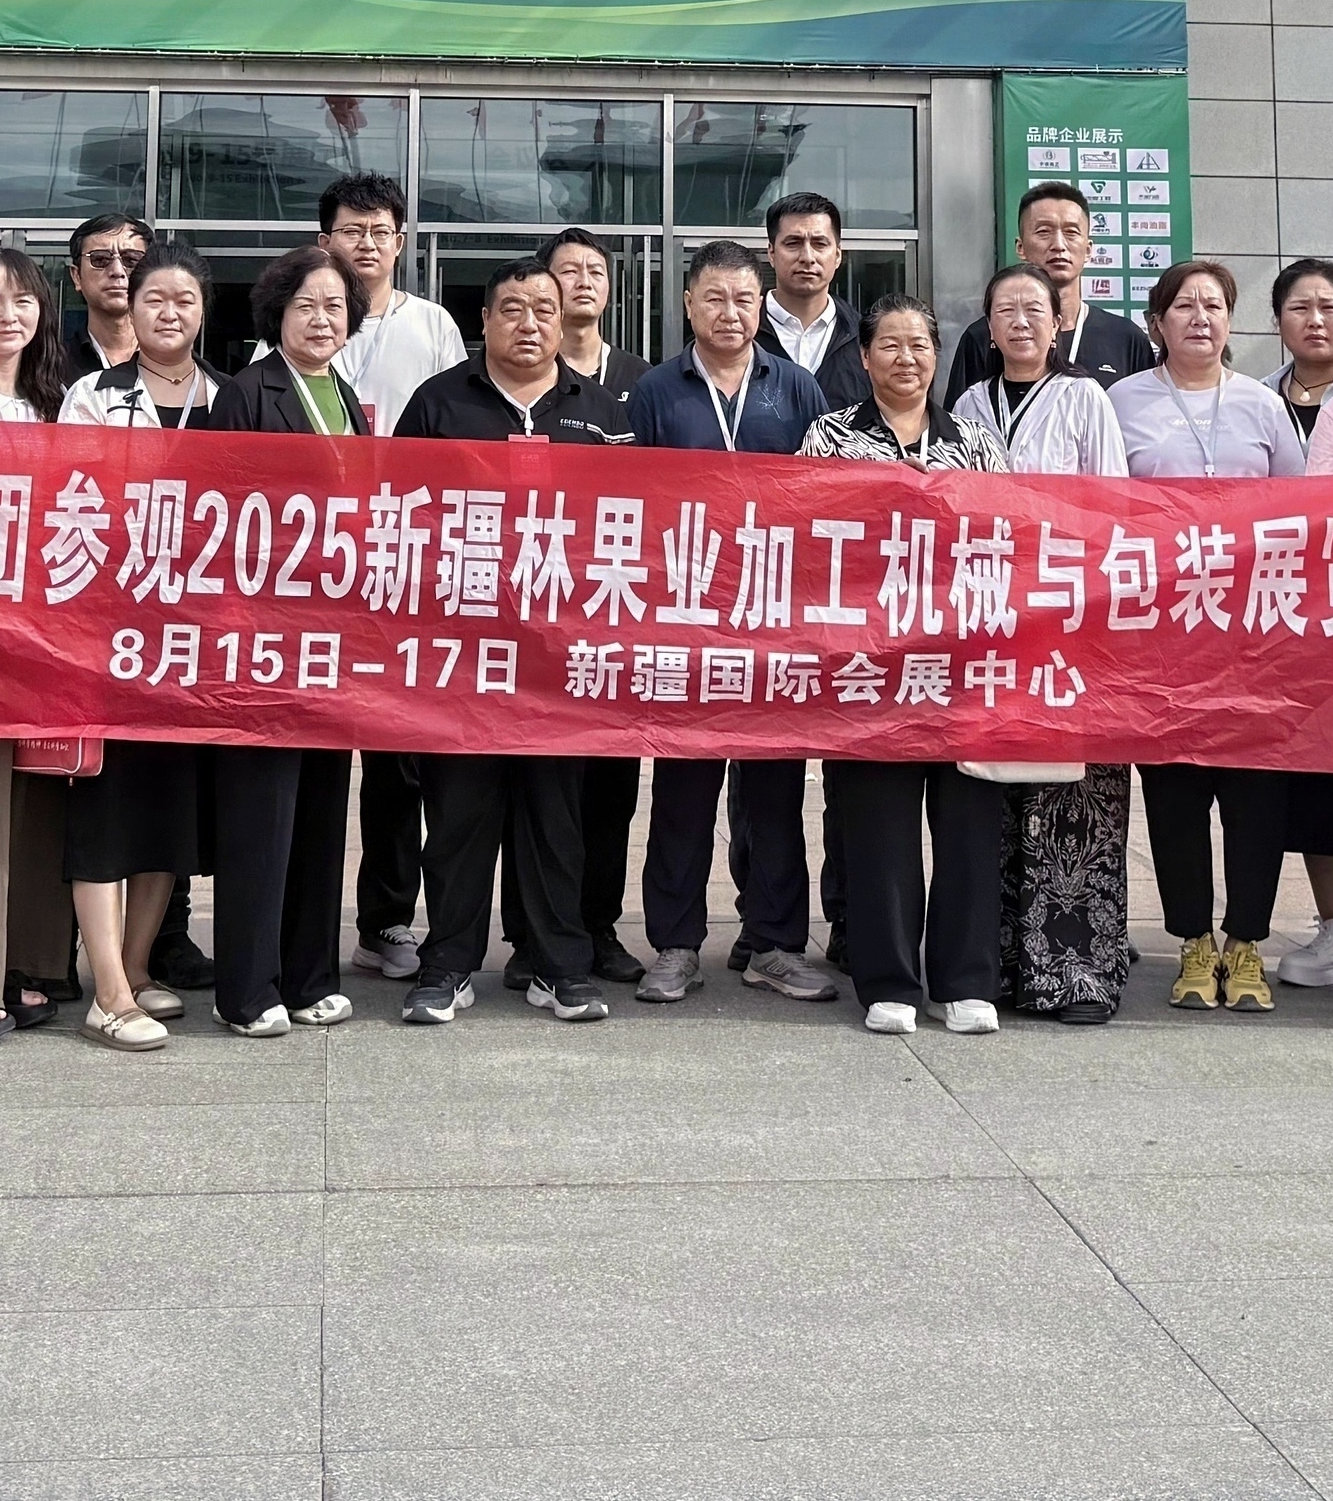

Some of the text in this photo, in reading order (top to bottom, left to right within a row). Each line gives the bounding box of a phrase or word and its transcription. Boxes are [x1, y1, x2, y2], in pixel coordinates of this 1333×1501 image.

[1027, 127, 1123, 144] 品牌企业展示
[565, 639, 1087, 709] 新疆国际会展中心
